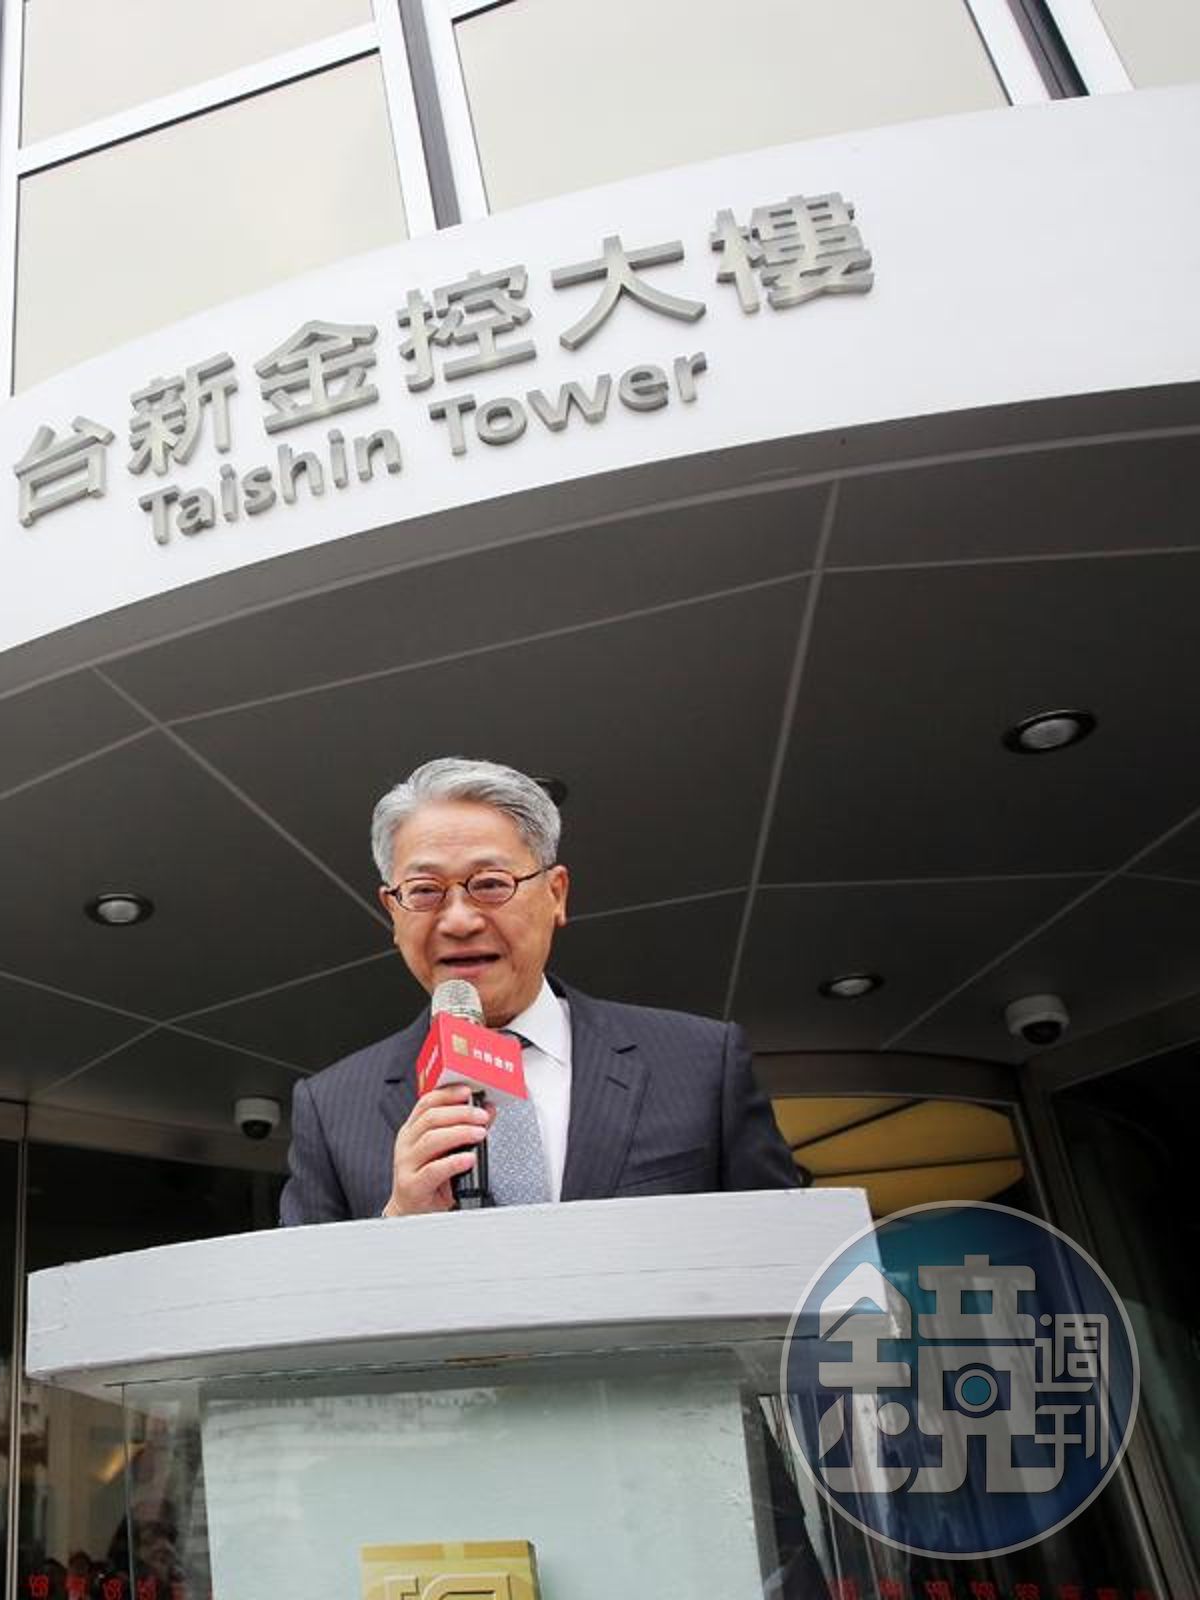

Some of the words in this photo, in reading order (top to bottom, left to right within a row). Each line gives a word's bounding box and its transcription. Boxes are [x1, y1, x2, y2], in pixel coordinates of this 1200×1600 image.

[13, 191, 874, 529] 台新金控大樓
[139, 428, 402, 545] Taishin
[429, 350, 707, 456] Tower
